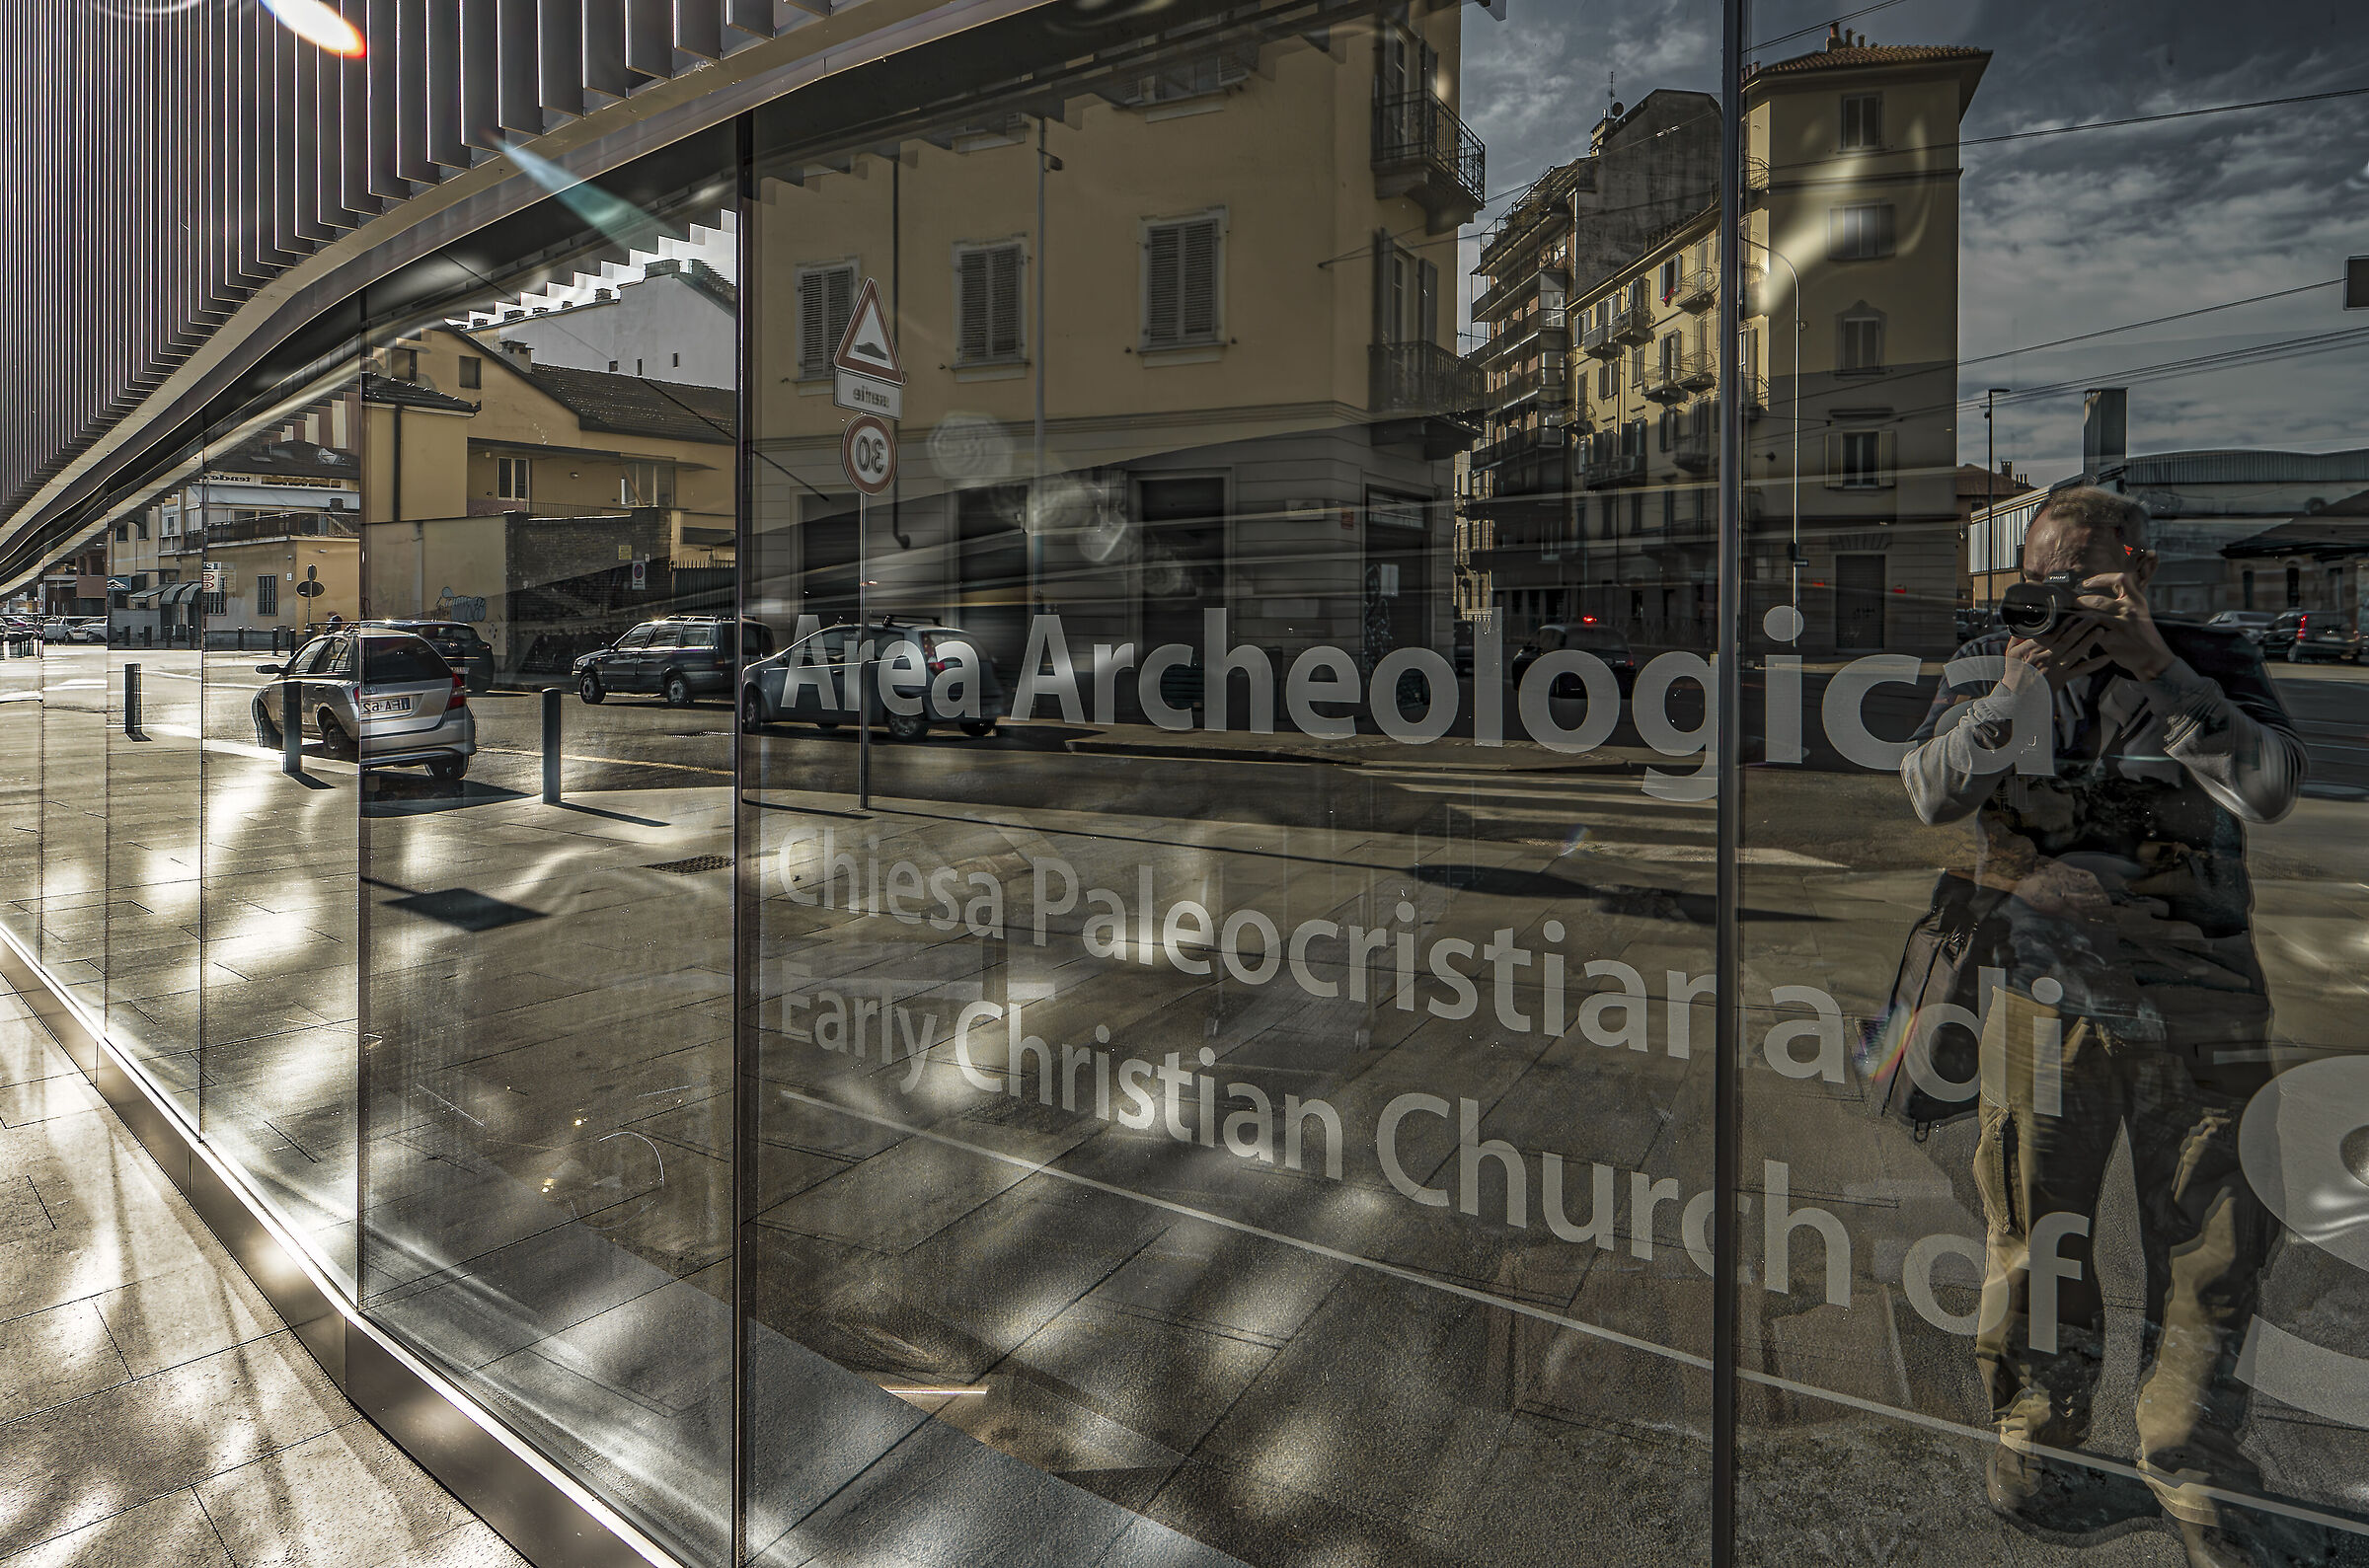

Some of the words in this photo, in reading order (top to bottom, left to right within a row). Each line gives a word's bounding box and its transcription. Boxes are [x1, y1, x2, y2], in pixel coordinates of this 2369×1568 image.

[781, 614, 981, 719] Area
[1010, 605, 2055, 801] Archeologica
[779, 826, 1004, 939] Chiesa
[1032, 857, 1846, 1083] Paleocristiana
[1903, 965, 2063, 1117] di
[781, 960, 938, 1093] Early
[955, 999, 1343, 1182] Christian
[1376, 1092, 1851, 1308] Church
[1902, 1211, 2090, 1355] of
